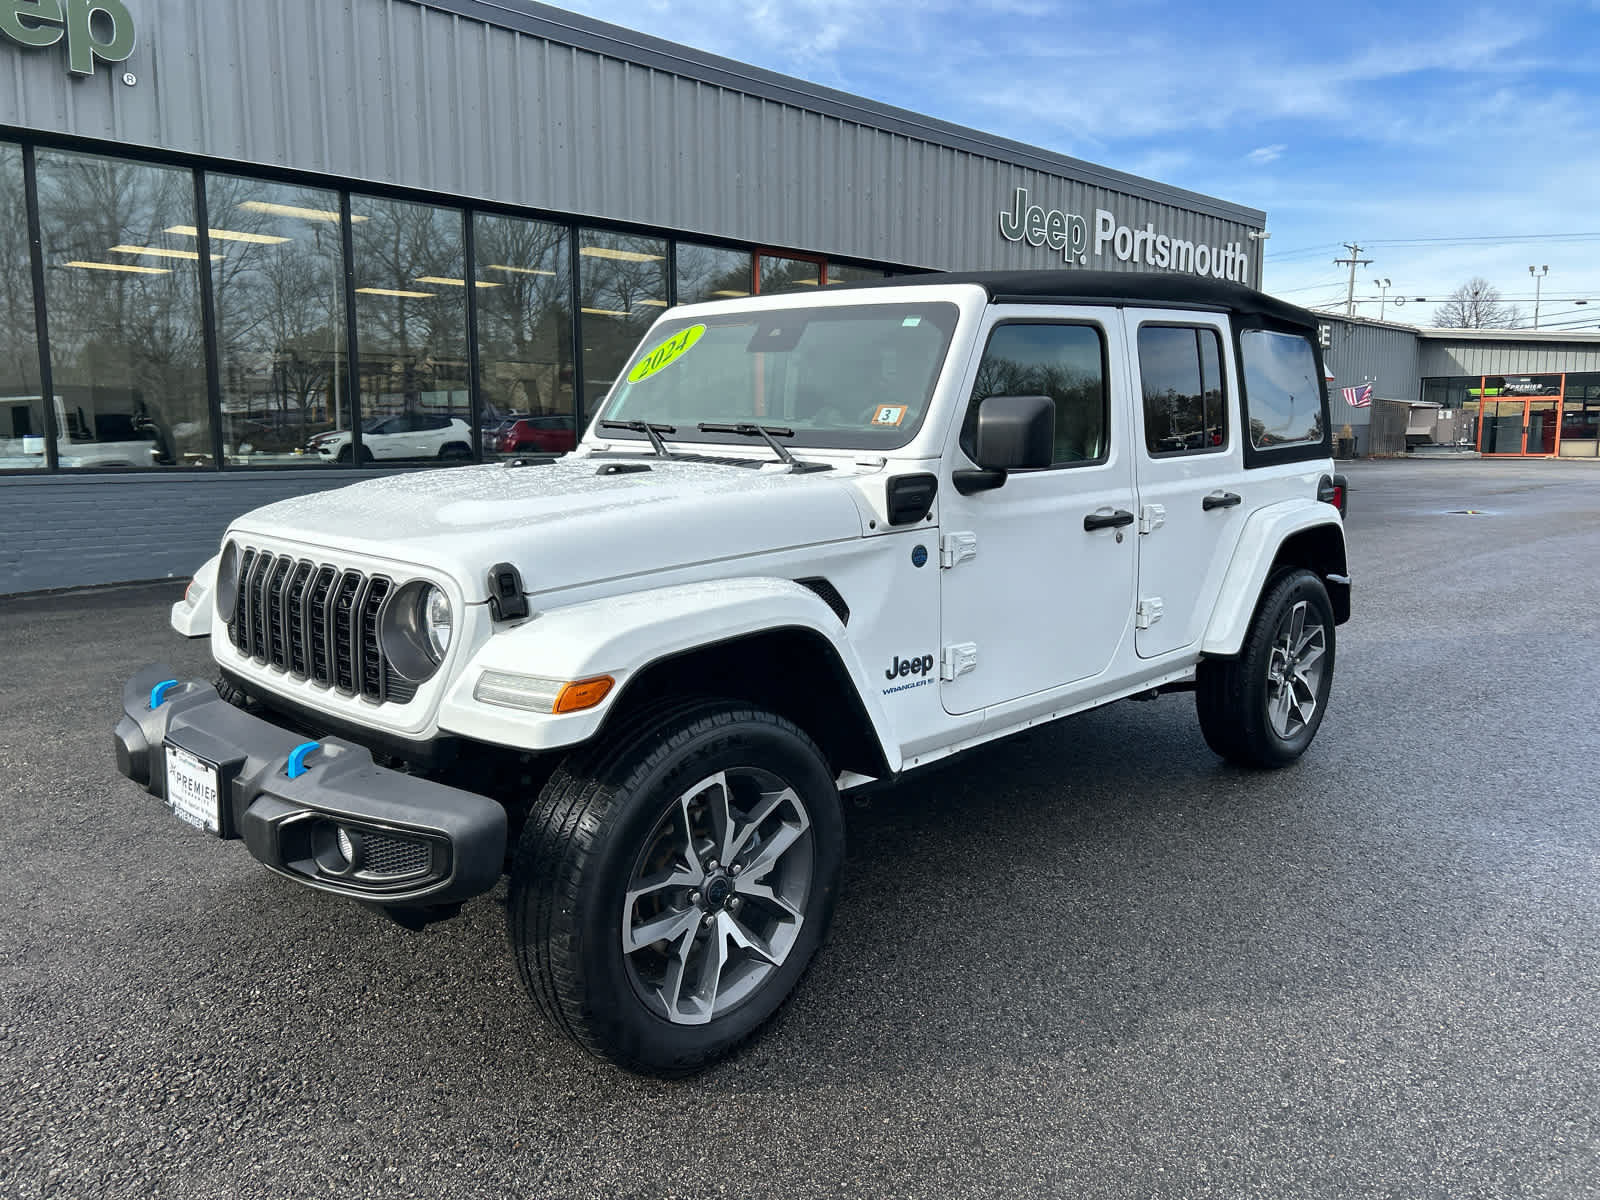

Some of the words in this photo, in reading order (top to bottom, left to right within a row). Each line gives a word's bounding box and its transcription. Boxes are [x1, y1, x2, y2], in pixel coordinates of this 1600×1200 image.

[1000, 187, 1087, 263] Jeep
[1095, 208, 1248, 283] Portsmouth
[1319, 325, 1331, 346] E
[638, 329, 691, 379] 2024
[881, 409, 891, 421] 3
[885, 654, 934, 680] Jeep
[882, 680, 927, 695] WRANGLER
[176, 772, 217, 801] PREMIER
